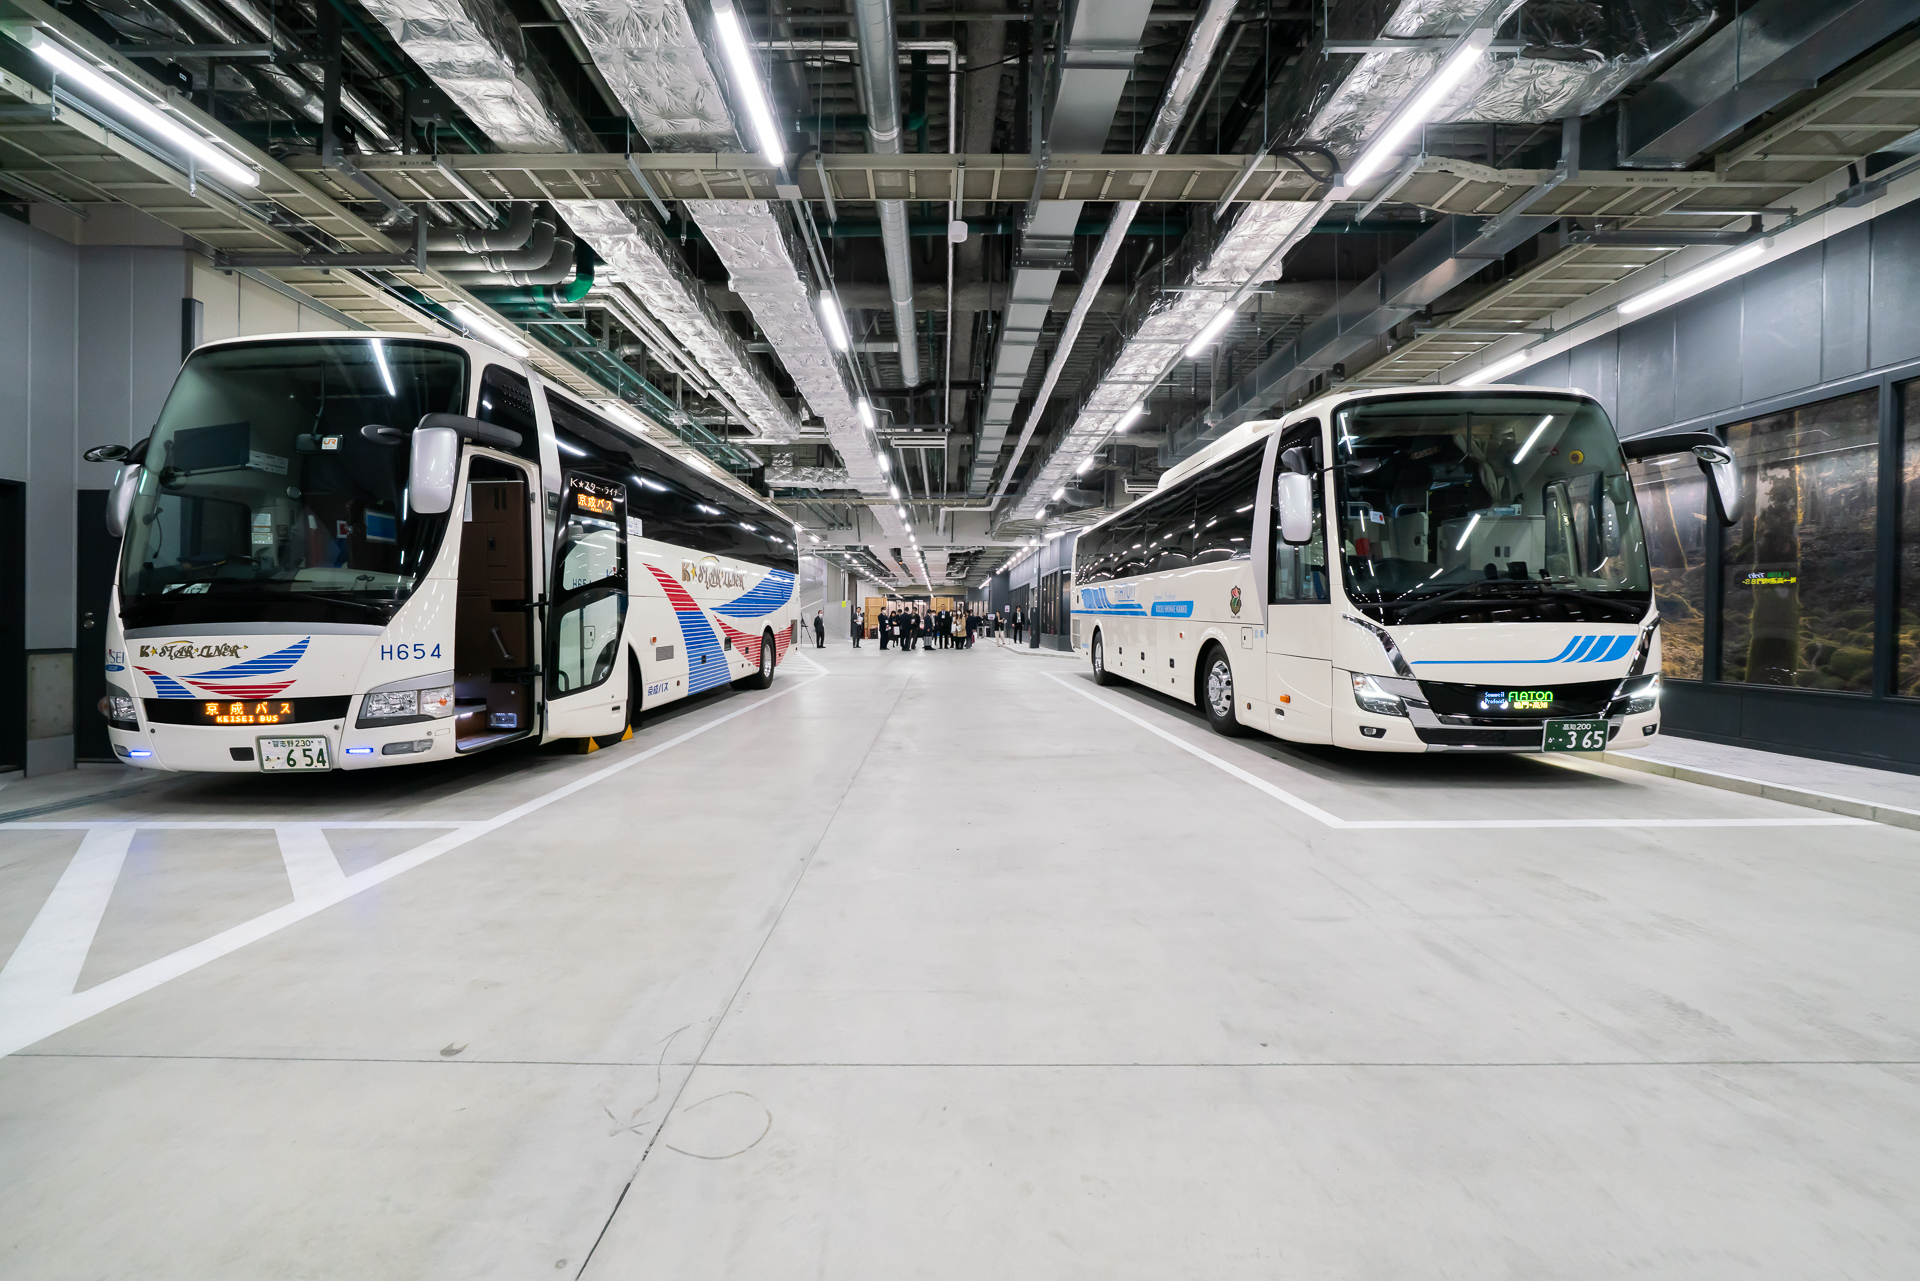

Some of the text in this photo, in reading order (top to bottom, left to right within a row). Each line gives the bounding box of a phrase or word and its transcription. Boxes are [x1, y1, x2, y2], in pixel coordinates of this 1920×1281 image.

[577, 493, 613, 512] 京成バス
[381, 643, 442, 661] H654
[205, 701, 291, 716] 京成バス
[215, 714, 280, 724] KEISEI BUS
[1566, 731, 1604, 748] 365
[286, 747, 327, 768] 654
